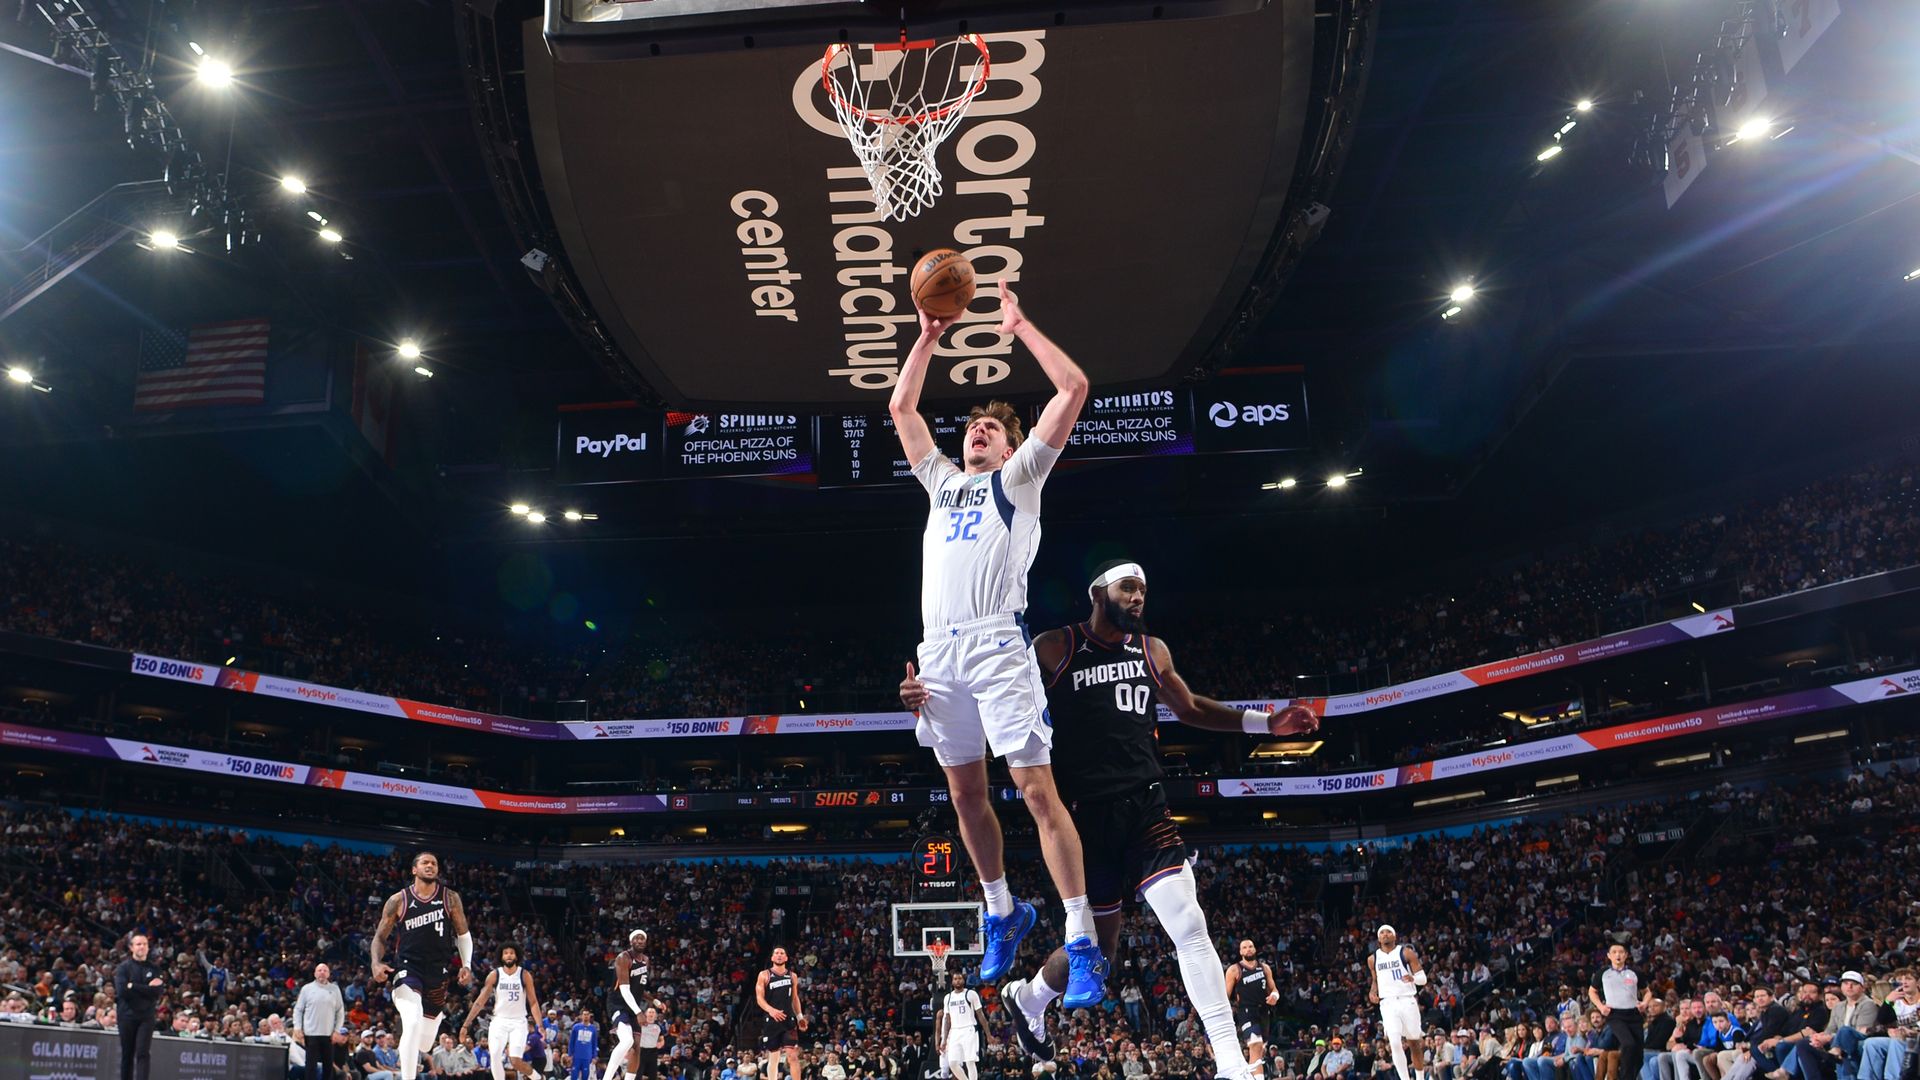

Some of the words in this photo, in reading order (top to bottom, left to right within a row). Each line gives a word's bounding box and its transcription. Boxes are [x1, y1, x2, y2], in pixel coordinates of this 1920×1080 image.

[933, 30, 1046, 385] mortgage
[730, 190, 802, 322] center
[827, 168, 917, 389] matchup
[720, 414, 797, 428] SPINATOS
[1242, 404, 1289, 426] aps
[842, 420, 867, 428] 66.7%
[1073, 420, 1114, 432] FICIAL
[1117, 418, 1152, 430] PIZZA
[1154, 417, 1172, 428] OF
[844, 430, 864, 438] 37/13
[1067, 435, 1081, 446] HE
[1084, 432, 1140, 444] PHOENIX
[1142, 430, 1176, 442] SUNS
[576, 432, 647, 458] PayPal
[684, 440, 738, 452] OFFICIAL
[740, 438, 774, 449] PIZZA
[776, 436, 794, 447] OF
[850, 440, 860, 448] 22
[681, 454, 705, 464] THE
[708, 452, 760, 463] PHOENIX
[762, 449, 797, 460] SUNS
[853, 450, 858, 458] 8
[852, 460, 860, 468] 10
[852, 470, 860, 478] 17
[946, 510, 982, 542] 32
[160, 662, 204, 680] BONUS
[1486, 654, 1565, 678] macu.com/suns150
[1072, 660, 1147, 692] PHOENIX
[297, 686, 337, 700] MyStyle
[1115, 682, 1150, 714] 00
[1366, 690, 1402, 706] MyStyle
[416, 708, 482, 726] macu.com/suns150
[816, 718, 853, 728] MyStyle
[666, 722, 690, 734] $150
[692, 720, 730, 733] BONUS
[1614, 718, 1703, 740] macu.com/suns150
[160, 755, 186, 763] AMERICA
[1472, 752, 1512, 768] MyStyle
[226, 758, 252, 773] $150
[254, 764, 295, 780] BONUS
[382, 782, 417, 794] MyStyle
[1318, 778, 1342, 792] $150
[1344, 774, 1385, 789] BONUS
[500, 800, 566, 809] macu.com/suns150
[815, 792, 858, 806] SUNS
[891, 793, 904, 802] 81
[930, 793, 948, 802] 5:46
[928, 843, 952, 854] 5:45
[924, 854, 950, 874] 21
[405, 908, 444, 930] PHOENIX
[434, 922, 444, 936] 4
[1378, 960, 1400, 971] DALLAS
[1392, 969, 1402, 980] 10
[500, 982, 520, 990] DALLAS
[1262, 979, 1266, 989] 3
[508, 991, 520, 1002] 35
[788, 987, 792, 996] 1
[959, 1006, 966, 1014] 13
[32, 1041, 61, 1056] GILA
[63, 1043, 98, 1058] RIVER
[180, 1052, 200, 1064] GILA
[202, 1053, 228, 1066] RIVER
